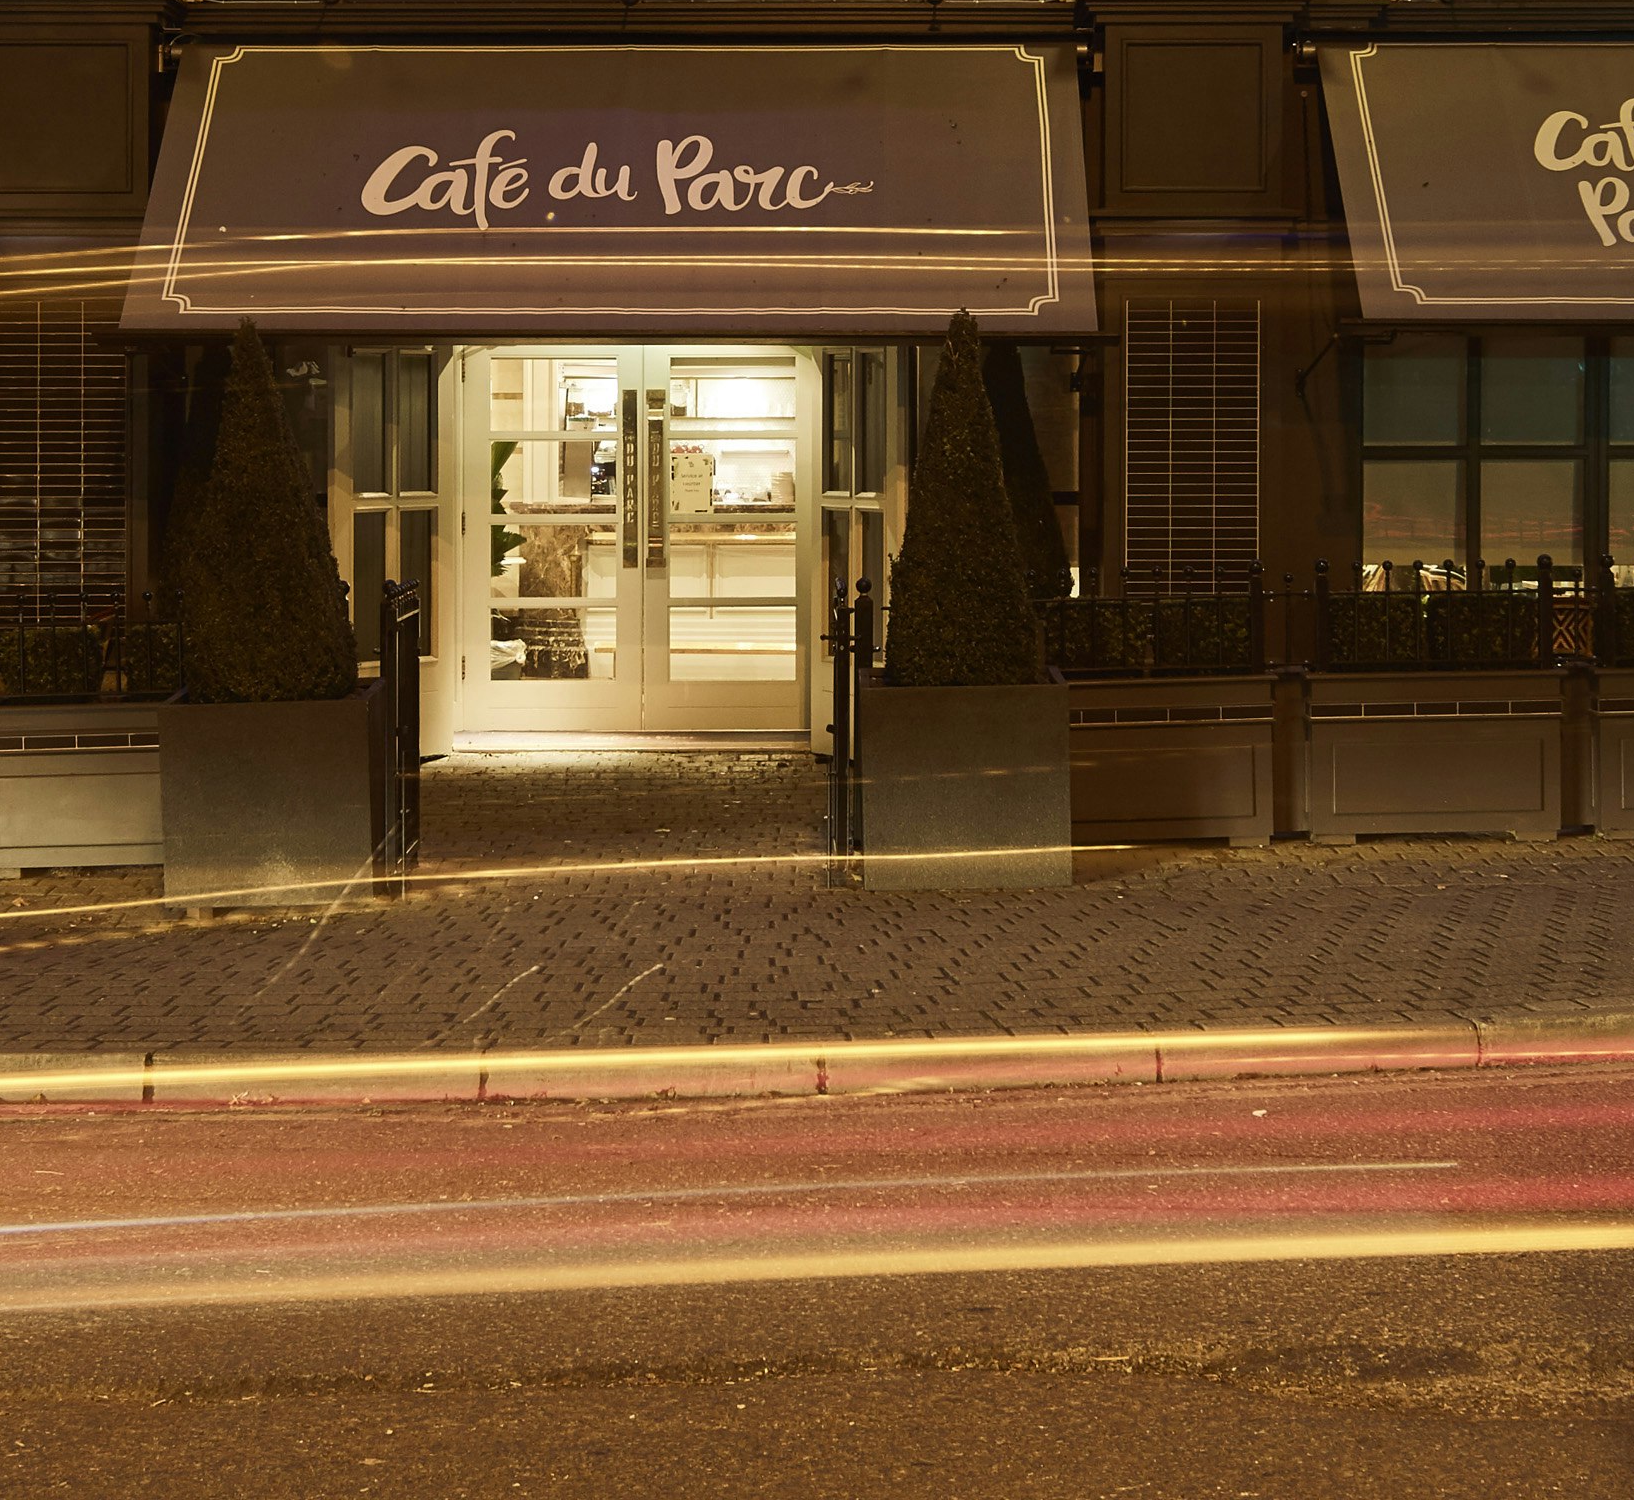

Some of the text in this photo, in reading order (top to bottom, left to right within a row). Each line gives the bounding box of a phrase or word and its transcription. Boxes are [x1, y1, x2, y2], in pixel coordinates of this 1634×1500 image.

[360, 129, 833, 231] Café du Parc
